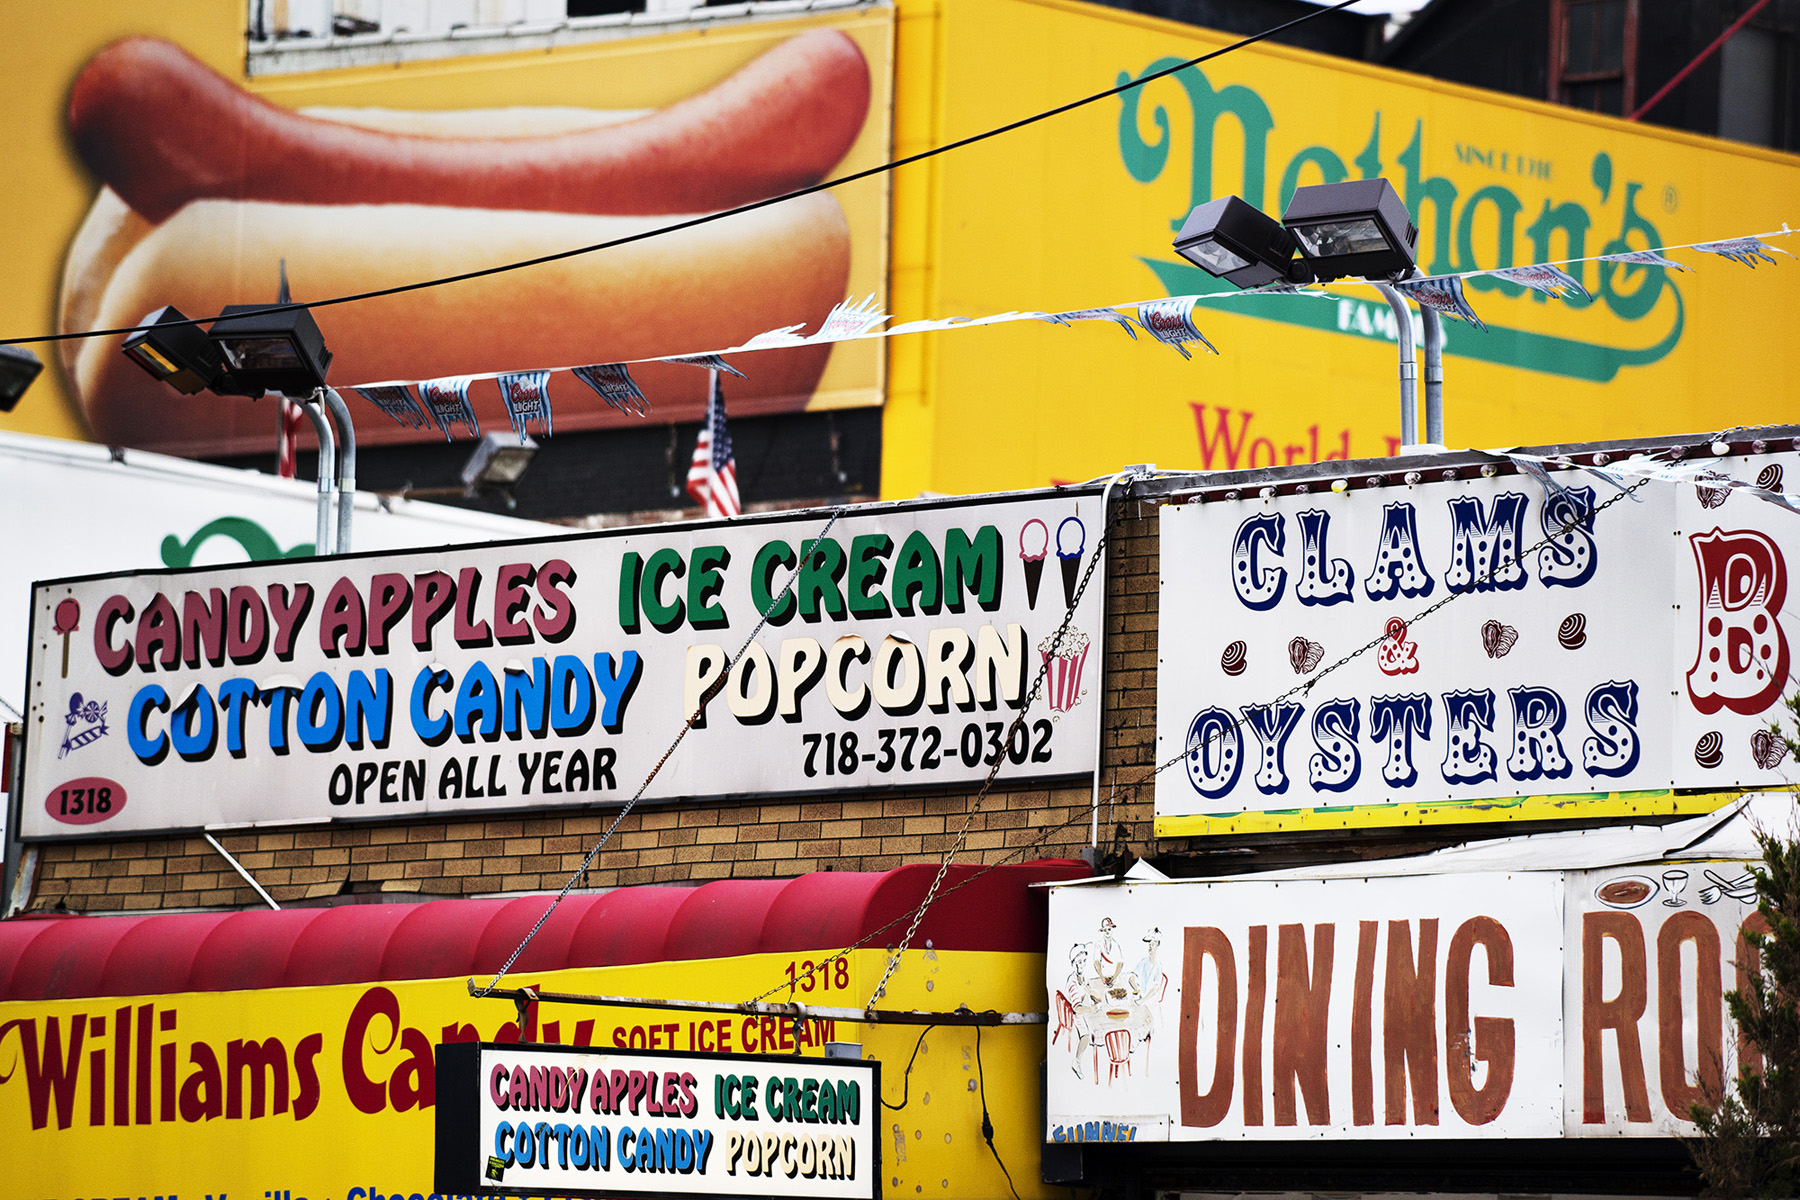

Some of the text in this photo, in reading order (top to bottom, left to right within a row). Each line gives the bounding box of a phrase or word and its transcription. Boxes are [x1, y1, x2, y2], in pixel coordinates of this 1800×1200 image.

[1117, 57, 1665, 320] Nhan's
[1150, 311, 1184, 331] Coors
[1160, 326, 1188, 339] LIGHT
[1337, 299, 1448, 348] FAM
[429, 386, 459, 404] Coors
[436, 403, 461, 415] LIGHT
[510, 383, 541, 402] Coors
[514, 400, 540, 413] LIGHT
[1231, 485, 1599, 612] CLAMS
[619, 525, 1003, 635] ICE CREAM
[94, 559, 577, 677] CANDY APPLES
[1377, 615, 1419, 676] &
[1686, 526, 1791, 716] B
[683, 623, 1030, 730] POPCORN
[127, 650, 644, 766] COTTON CANDY
[802, 719, 1054, 779] 718-372-0302
[1184, 679, 1641, 800] OYSTERS
[59, 786, 111, 816] 1318
[329, 748, 617, 806] OPEN ALL YEAR
[785, 957, 849, 993] 1318
[612, 1013, 836, 1053] SOFT ICE CREAM
[1178, 914, 1516, 1128] DINING
[0, 1002, 323, 1131] Williams
[489, 1063, 698, 1118] CANDY APPLES
[714, 1073, 861, 1124] ICE CREAM
[494, 1120, 714, 1174] COTTON CANDY
[725, 1130, 857, 1180] POPCORN
